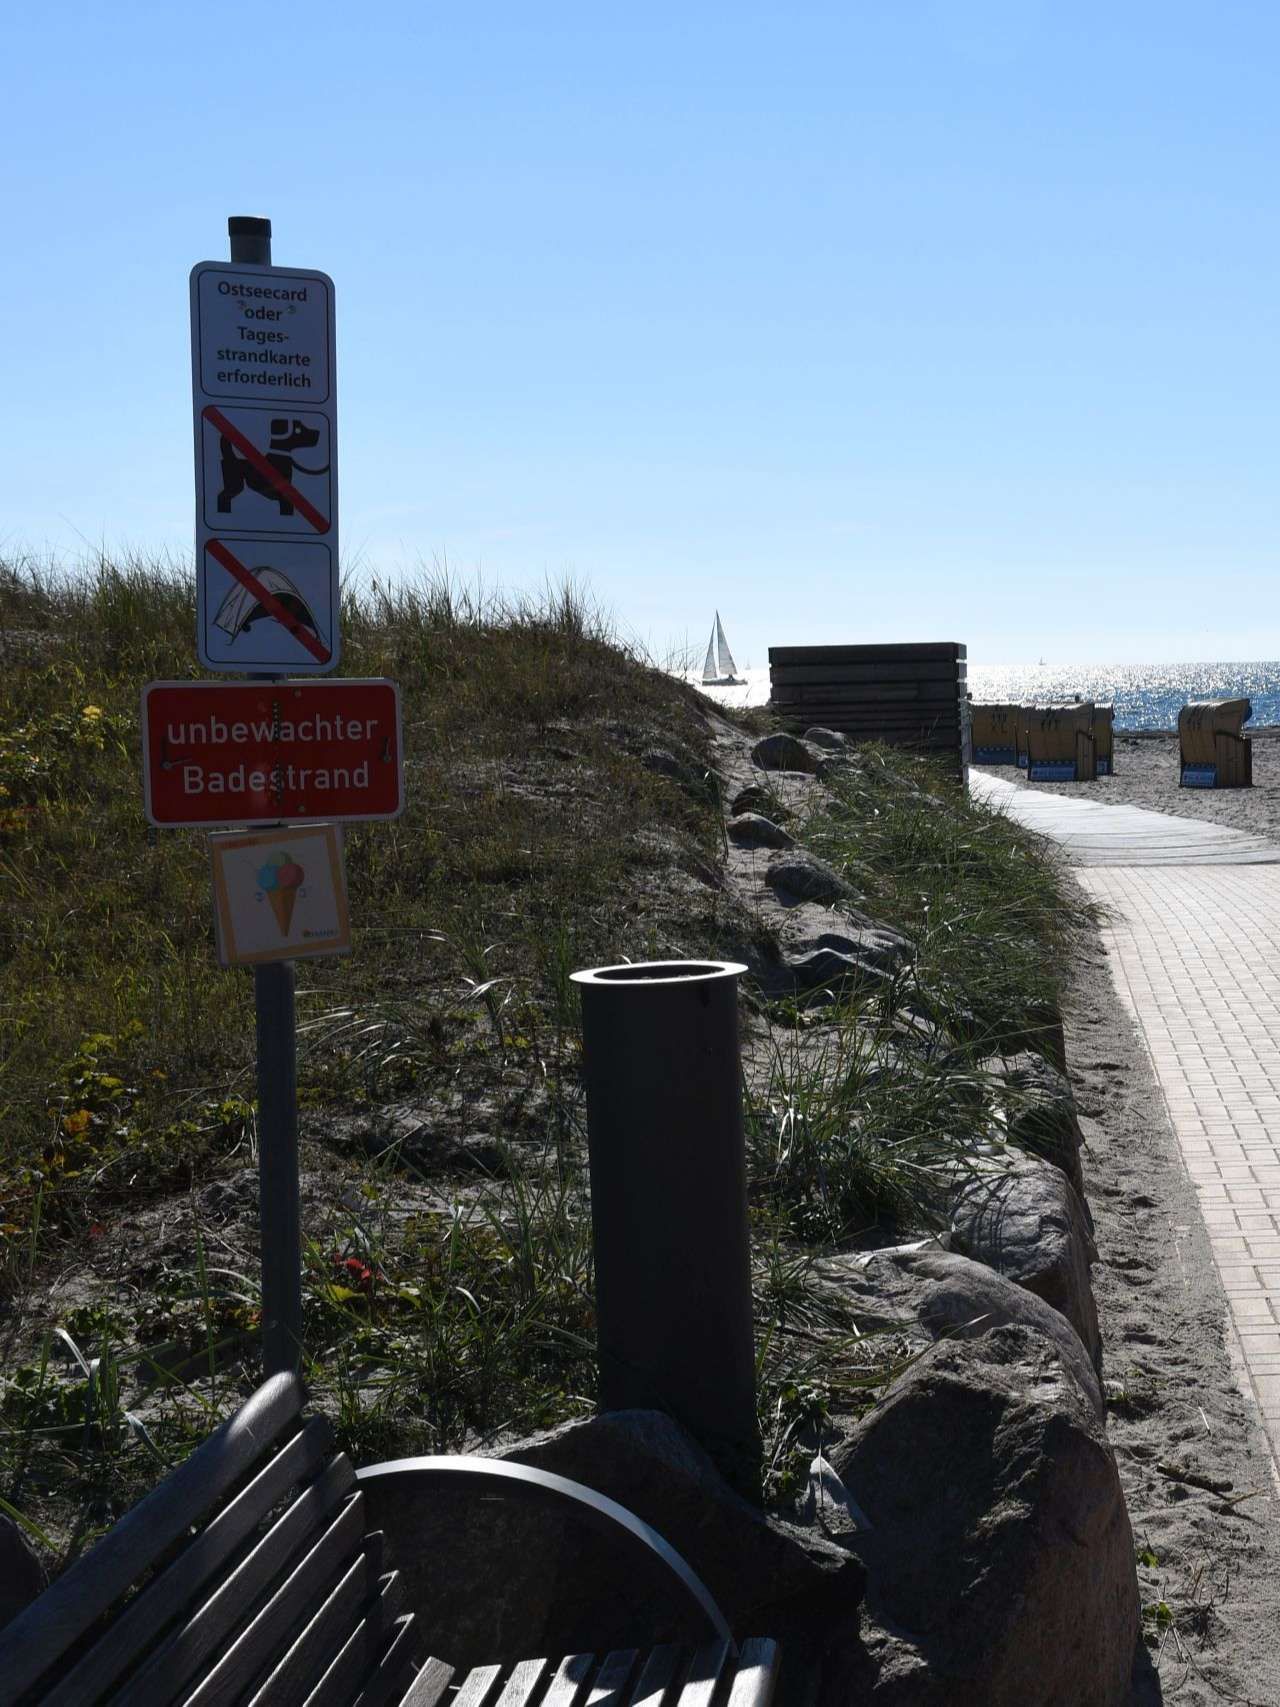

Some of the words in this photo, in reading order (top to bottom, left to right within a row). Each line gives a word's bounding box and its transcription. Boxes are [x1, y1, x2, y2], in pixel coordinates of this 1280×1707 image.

[218, 281, 307, 301] Ostseecard
[244, 306, 282, 321] oder
[237, 326, 289, 345] Tages-
[217, 348, 311, 367] strandkarte
[217, 368, 311, 388] erforderlich
[168, 714, 378, 745] unbewachter
[183, 760, 369, 793] Badestrand
